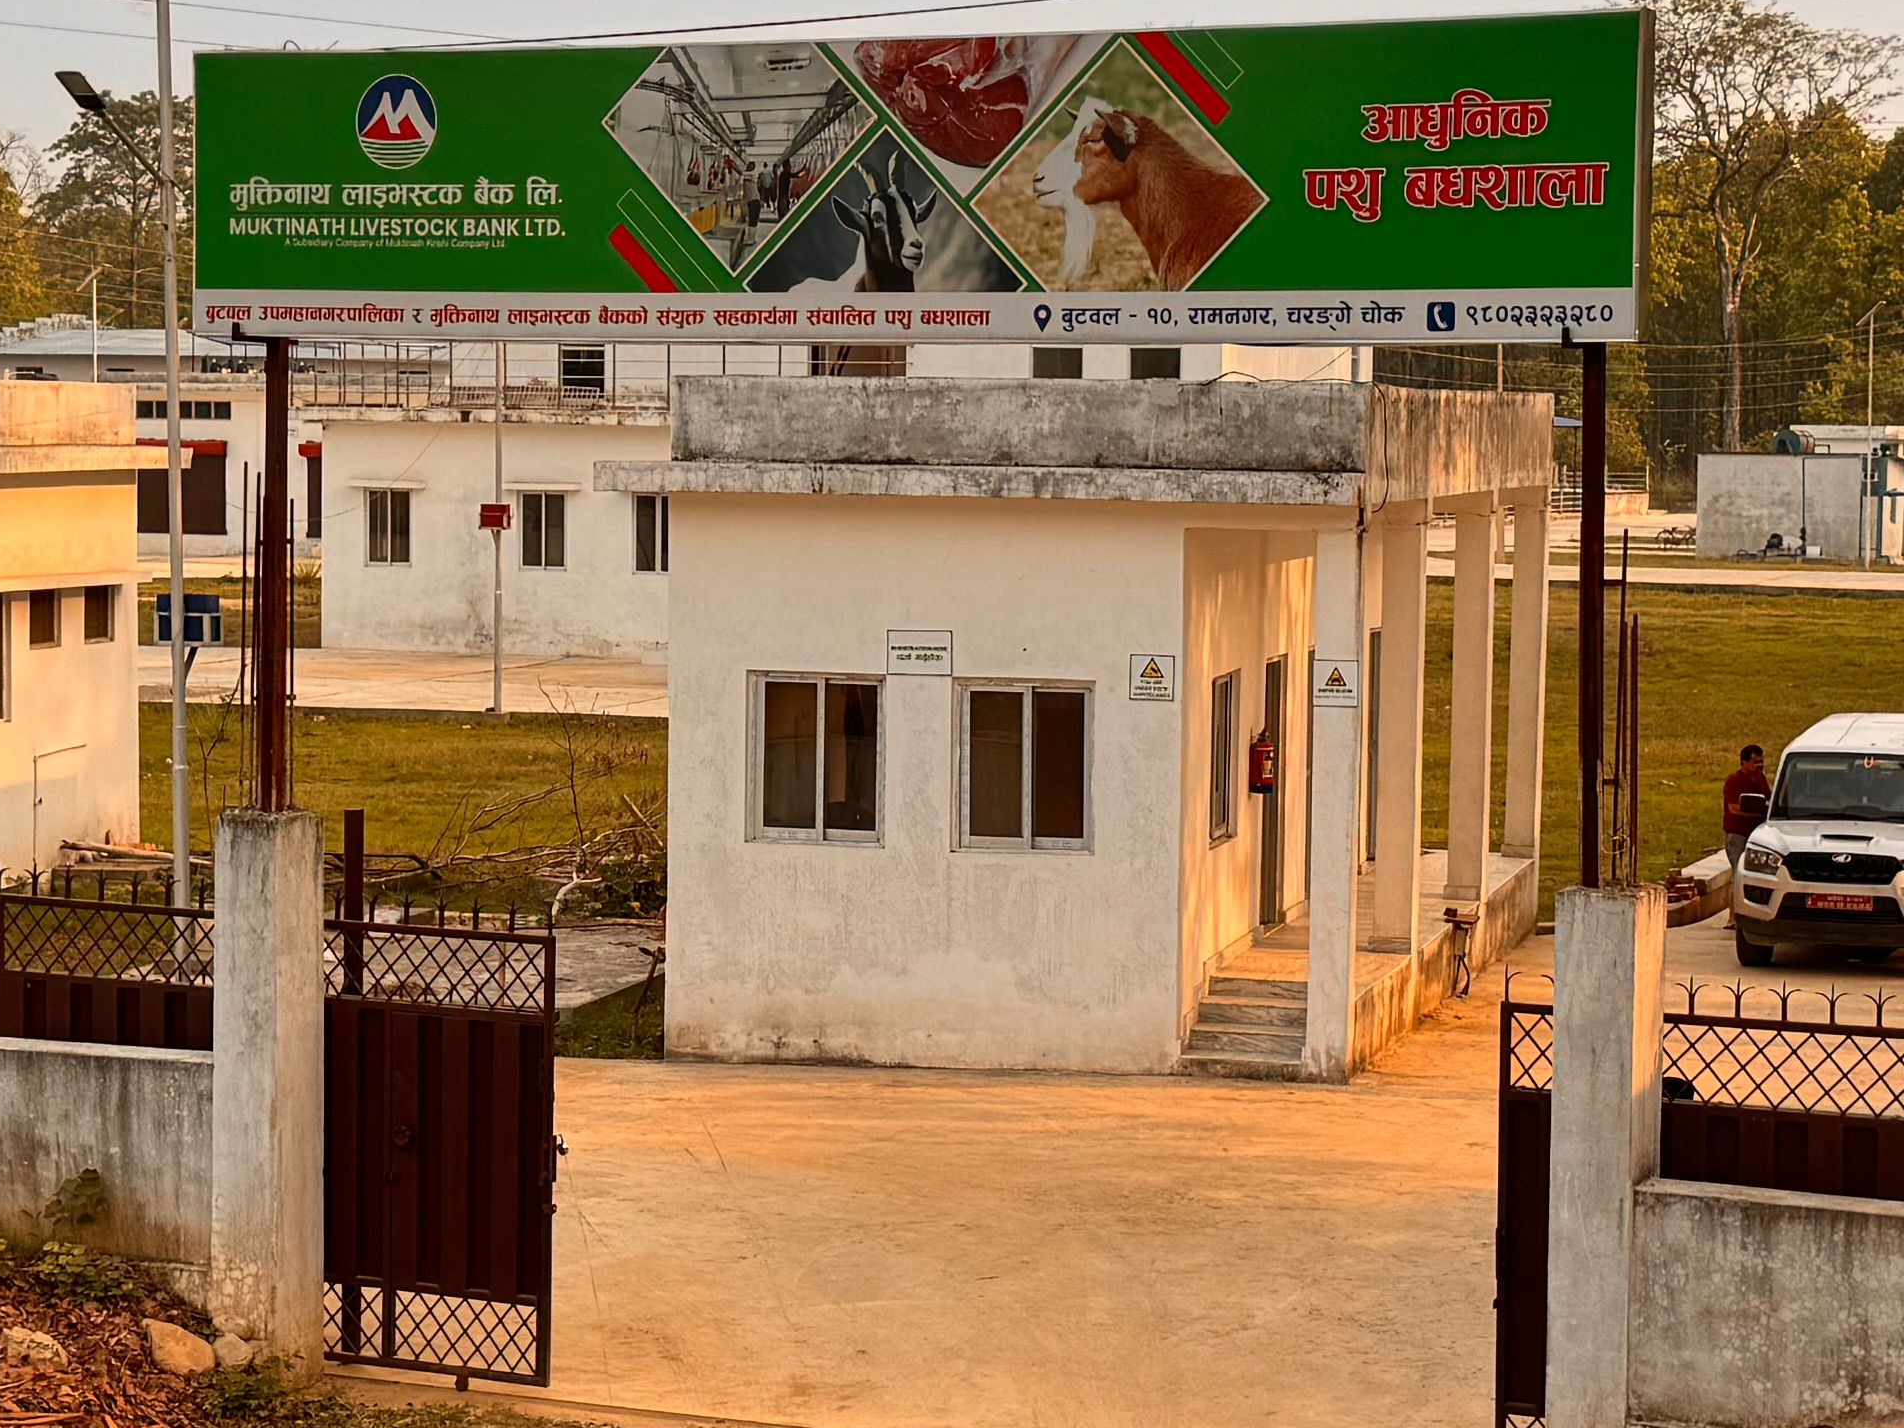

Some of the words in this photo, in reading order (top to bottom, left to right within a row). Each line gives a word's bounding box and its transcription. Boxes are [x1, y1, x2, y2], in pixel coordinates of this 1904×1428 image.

[1361, 88, 1551, 151] आधुनिक
[229, 175, 332, 211] मुक्तिनाथ
[342, 184, 464, 208] लाइभस्टक
[474, 176, 515, 205] बैंक
[526, 175, 562, 205] लि.
[1303, 168, 1386, 223] पशु
[229, 218, 345, 236] MUKTINATH
[350, 218, 458, 236] LIVESTOCK
[463, 218, 519, 236] BANK
[525, 218, 566, 236] LTD.
[258, 303, 405, 322] उपमहानगरपालिका
[412, 308, 423, 323] र
[430, 304, 499, 327] मुक्तिनाथ
[507, 309, 591, 326] लाइभस्टक
[656, 306, 706, 329] संयुक्त
[713, 306, 798, 326] सहकार्यमा
[806, 305, 876, 326] संचालित
[885, 310, 912, 330] पशु
[1061, 308, 1121, 332] बुटवल
[1147, 307, 1178, 327] १०,
[1188, 307, 1277, 327] रामनगर,
[1360, 300, 1405, 323] चोक
[1466, 304, 1613, 327] ९८०२३२३२८०
